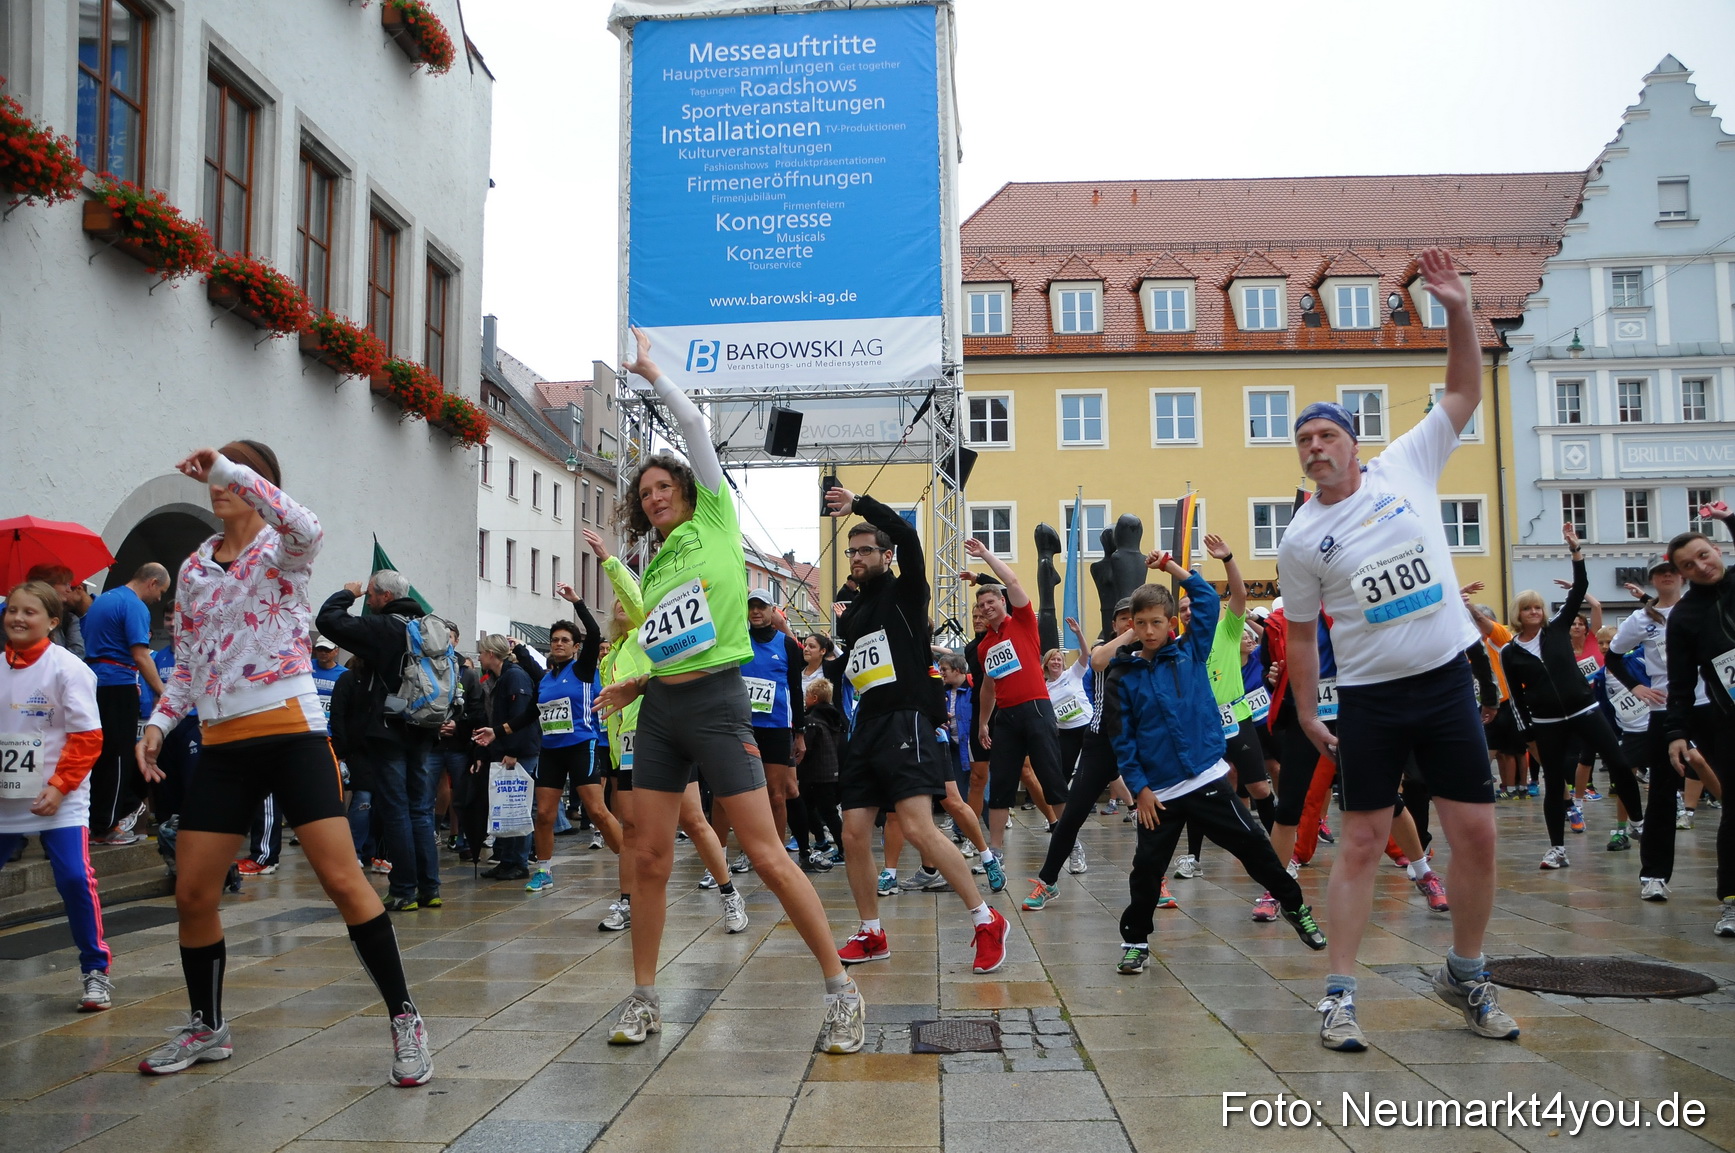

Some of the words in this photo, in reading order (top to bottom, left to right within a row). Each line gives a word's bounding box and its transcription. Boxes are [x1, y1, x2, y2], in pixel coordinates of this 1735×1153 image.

[689, 35, 877, 63] Messeauftritte
[662, 60, 834, 82] Hauptversammlungen
[839, 62, 856, 72] Get
[858, 60, 900, 72] together
[690, 86, 736, 98] Tagungen
[740, 78, 857, 98] Roadshows
[681, 96, 886, 122] Sportveranstaltungen
[661, 118, 821, 145] Installationen
[824, 121, 906, 134] TV-Produktionen
[678, 141, 832, 160] Kulturveranstaltungen
[704, 160, 769, 172] Fashionshows
[774, 156, 886, 170] Produktpräsentationen
[687, 168, 873, 193] Firmeneröffnungen
[711, 192, 786, 204] Firmenjubiläum
[782, 200, 846, 211] Firmenfeiern
[716, 210, 832, 234] Kongresse
[776, 231, 826, 244] Musicals
[726, 244, 814, 262] Konzerte
[748, 260, 802, 270] Tourservice
[710, 290, 858, 308] www.barowski-ag.de
[726, 340, 843, 360] BAROWSKI
[850, 338, 883, 357] AG
[727, 362, 794, 370] Veranstaltungs-
[815, 358, 882, 368] Mediensysteme
[1628, 446, 1698, 463] BRILLEN
[1376, 549, 1414, 568] Neumarkt
[1362, 558, 1431, 604] 3180
[658, 590, 691, 614] Neumarkt
[1373, 590, 1434, 622] FRANK
[645, 598, 704, 644] 2412
[661, 634, 697, 656] Daniela
[986, 648, 1014, 670] 2098
[748, 686, 770, 702] 174
[542, 706, 569, 721] 5173
[1057, 700, 1077, 716] 5017
[0, 750, 36, 773] 24
[0, 780, 21, 789] iana
